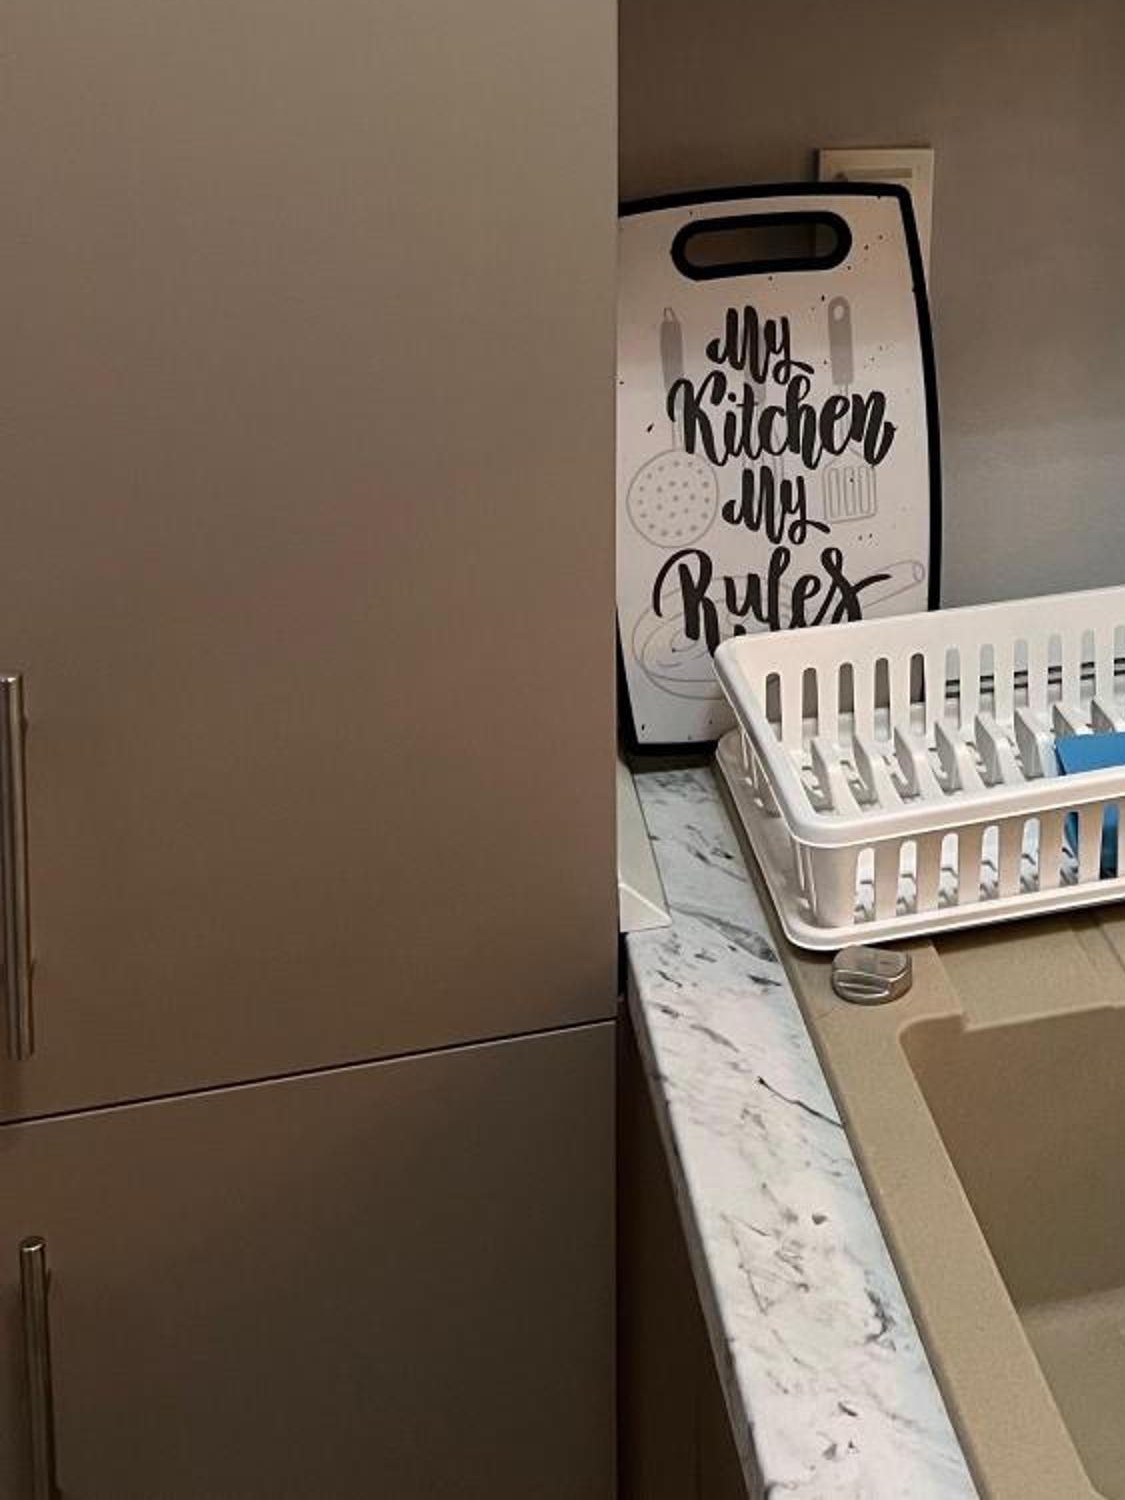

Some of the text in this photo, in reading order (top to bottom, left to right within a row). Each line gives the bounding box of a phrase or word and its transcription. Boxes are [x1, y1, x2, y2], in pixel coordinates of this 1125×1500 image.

[706, 305, 814, 386] My
[667, 370, 896, 469] Kitchen
[721, 466, 830, 544] My
[653, 546, 892, 657] Rules
